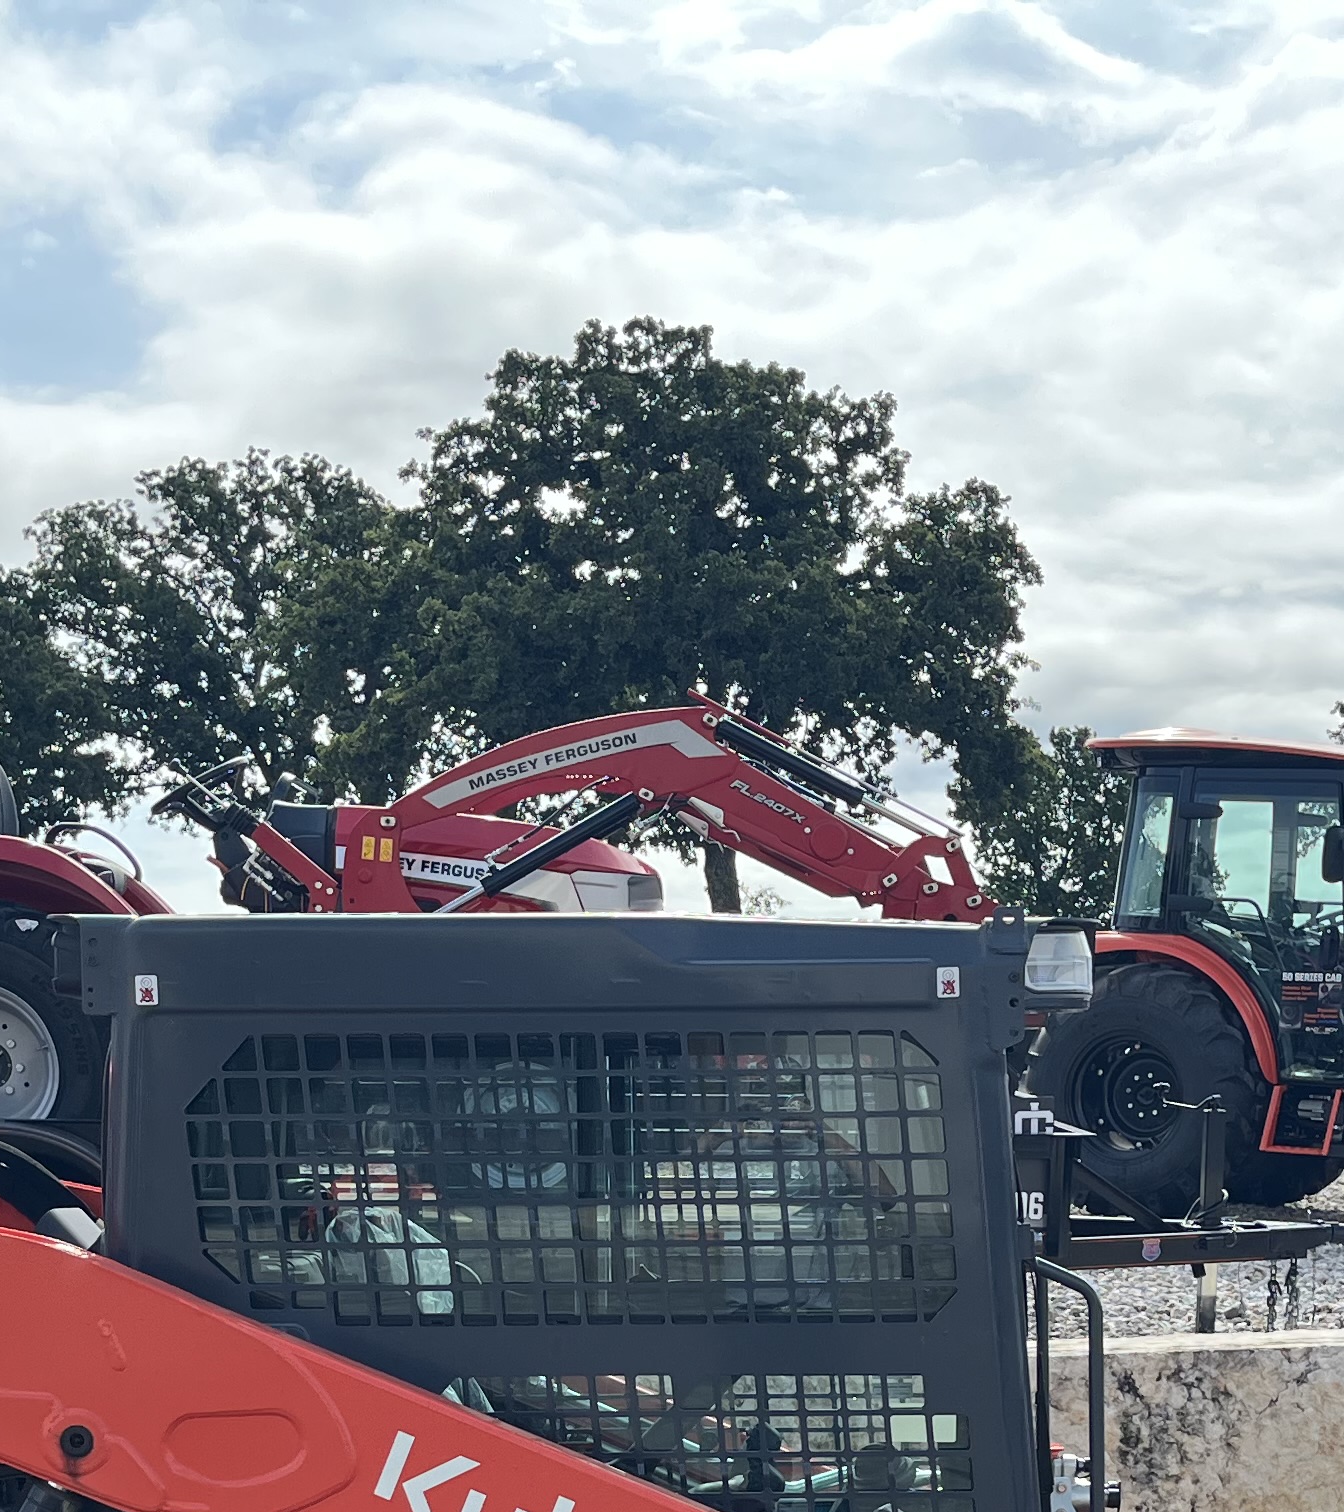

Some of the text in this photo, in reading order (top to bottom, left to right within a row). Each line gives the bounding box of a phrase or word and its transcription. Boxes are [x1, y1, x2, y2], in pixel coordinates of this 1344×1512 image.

[468, 733, 637, 790] MASSEY FERGUSON
[420, 858, 490, 880] FERGUS
[1294, 972, 1324, 982] SERIES
